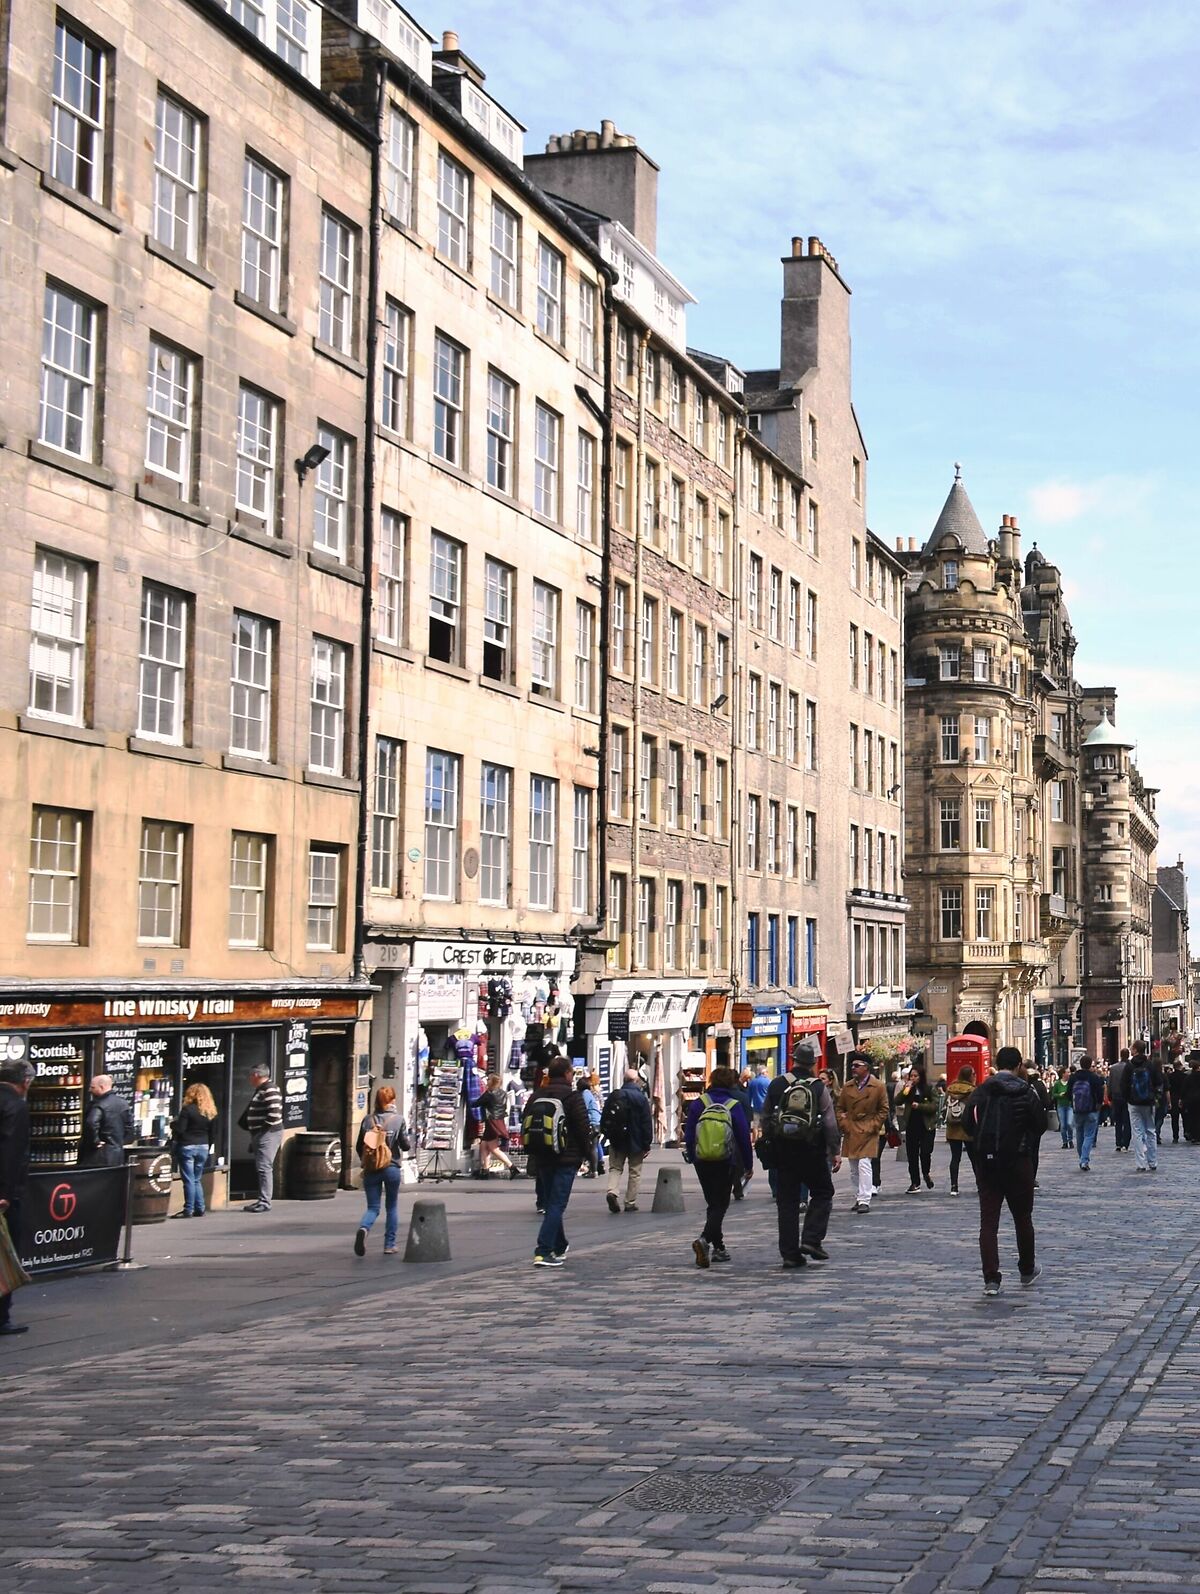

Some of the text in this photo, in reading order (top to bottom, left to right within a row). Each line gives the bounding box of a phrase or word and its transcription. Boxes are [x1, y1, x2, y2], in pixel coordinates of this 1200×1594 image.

[380, 946, 398, 962] 219
[443, 946, 481, 964] CREST
[501, 949, 556, 966] EDINBURGH
[16, 1002, 51, 1017] Whisky
[104, 998, 234, 1020] The Whisky Trail
[30, 1043, 76, 1059] Scottish
[107, 1039, 135, 1051] SCOTCH
[137, 1038, 168, 1058] Single
[187, 1036, 221, 1051] Whisky
[105, 1051, 136, 1062] WHISKY
[140, 1055, 164, 1069] Malt
[182, 1053, 225, 1070] Specialist
[36, 1063, 69, 1077] Beers
[34, 1226, 85, 1245] GORDON'S
